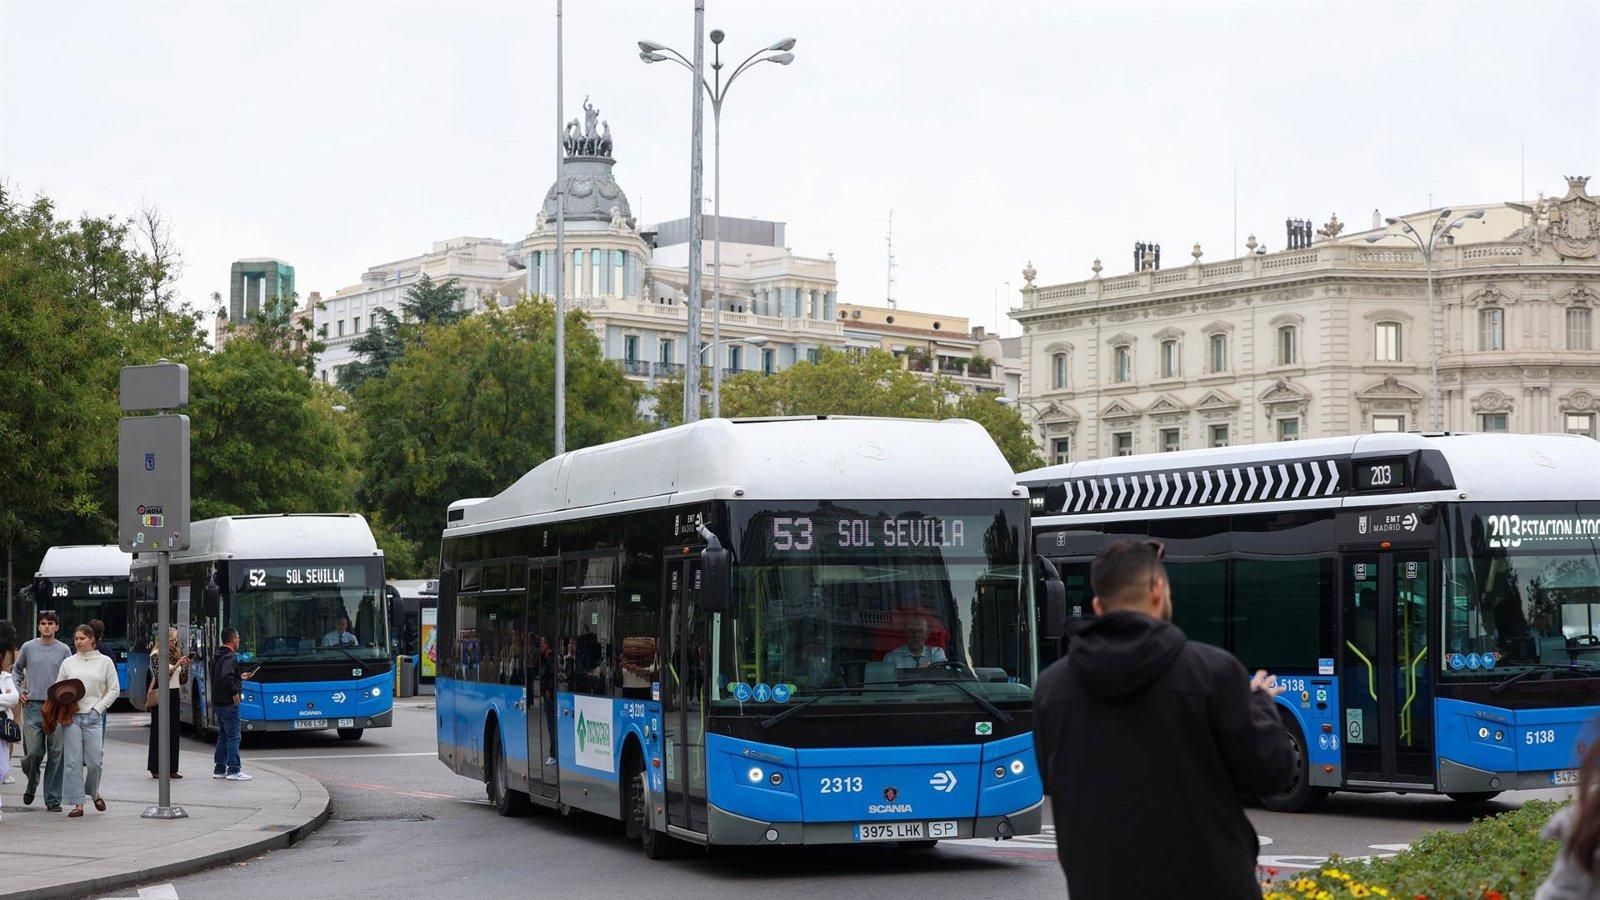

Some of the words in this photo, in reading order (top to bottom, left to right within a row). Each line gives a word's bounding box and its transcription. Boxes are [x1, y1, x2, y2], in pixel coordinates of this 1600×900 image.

[1371, 465, 1391, 485] 203
[1386, 515, 1401, 524] EMT
[773, 517, 813, 550] 53
[838, 519, 875, 547] SOL
[883, 519, 965, 547] SEVILLA
[1373, 523, 1401, 532] MADRID
[1488, 515, 1521, 548] 203
[1521, 519, 1572, 541] ESTACION
[249, 569, 266, 587] 52
[286, 569, 304, 584] SOL
[306, 568, 345, 584] SEVILLA
[52, 584, 68, 597] 146
[1281, 679, 1304, 692] 5138
[272, 695, 297, 704] 2443
[1526, 729, 1555, 745] 5138
[820, 777, 863, 794] 2313
[868, 804, 913, 814] SCANIA
[862, 825, 894, 839] 3975
[897, 823, 921, 837] LHK
[933, 823, 954, 836] SP
